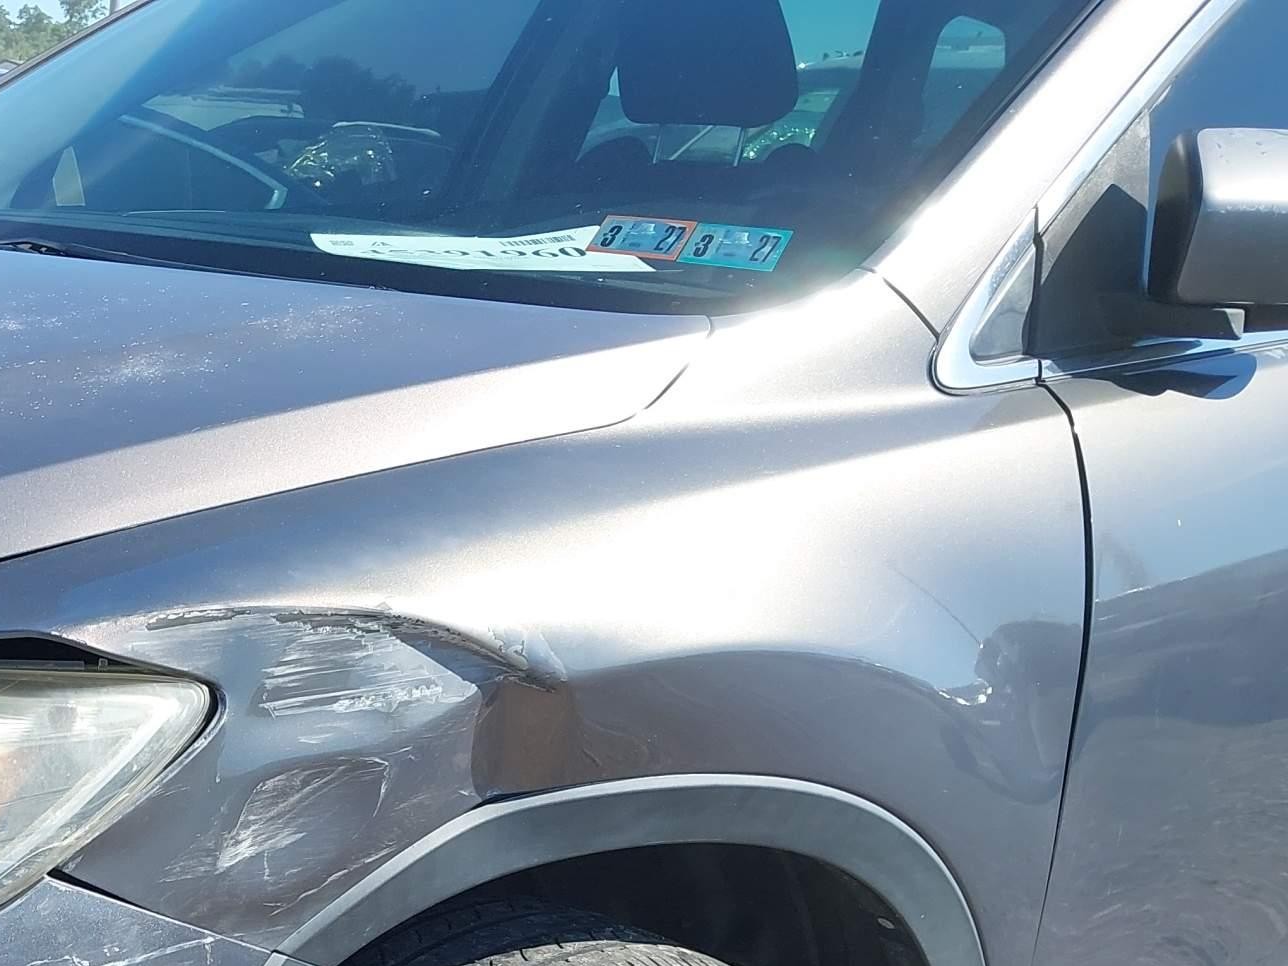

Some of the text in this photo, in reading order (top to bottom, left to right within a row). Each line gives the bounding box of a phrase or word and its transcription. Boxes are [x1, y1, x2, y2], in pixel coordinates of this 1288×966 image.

[599, 225, 688, 254] 3 27
[693, 233, 781, 263] 3 27
